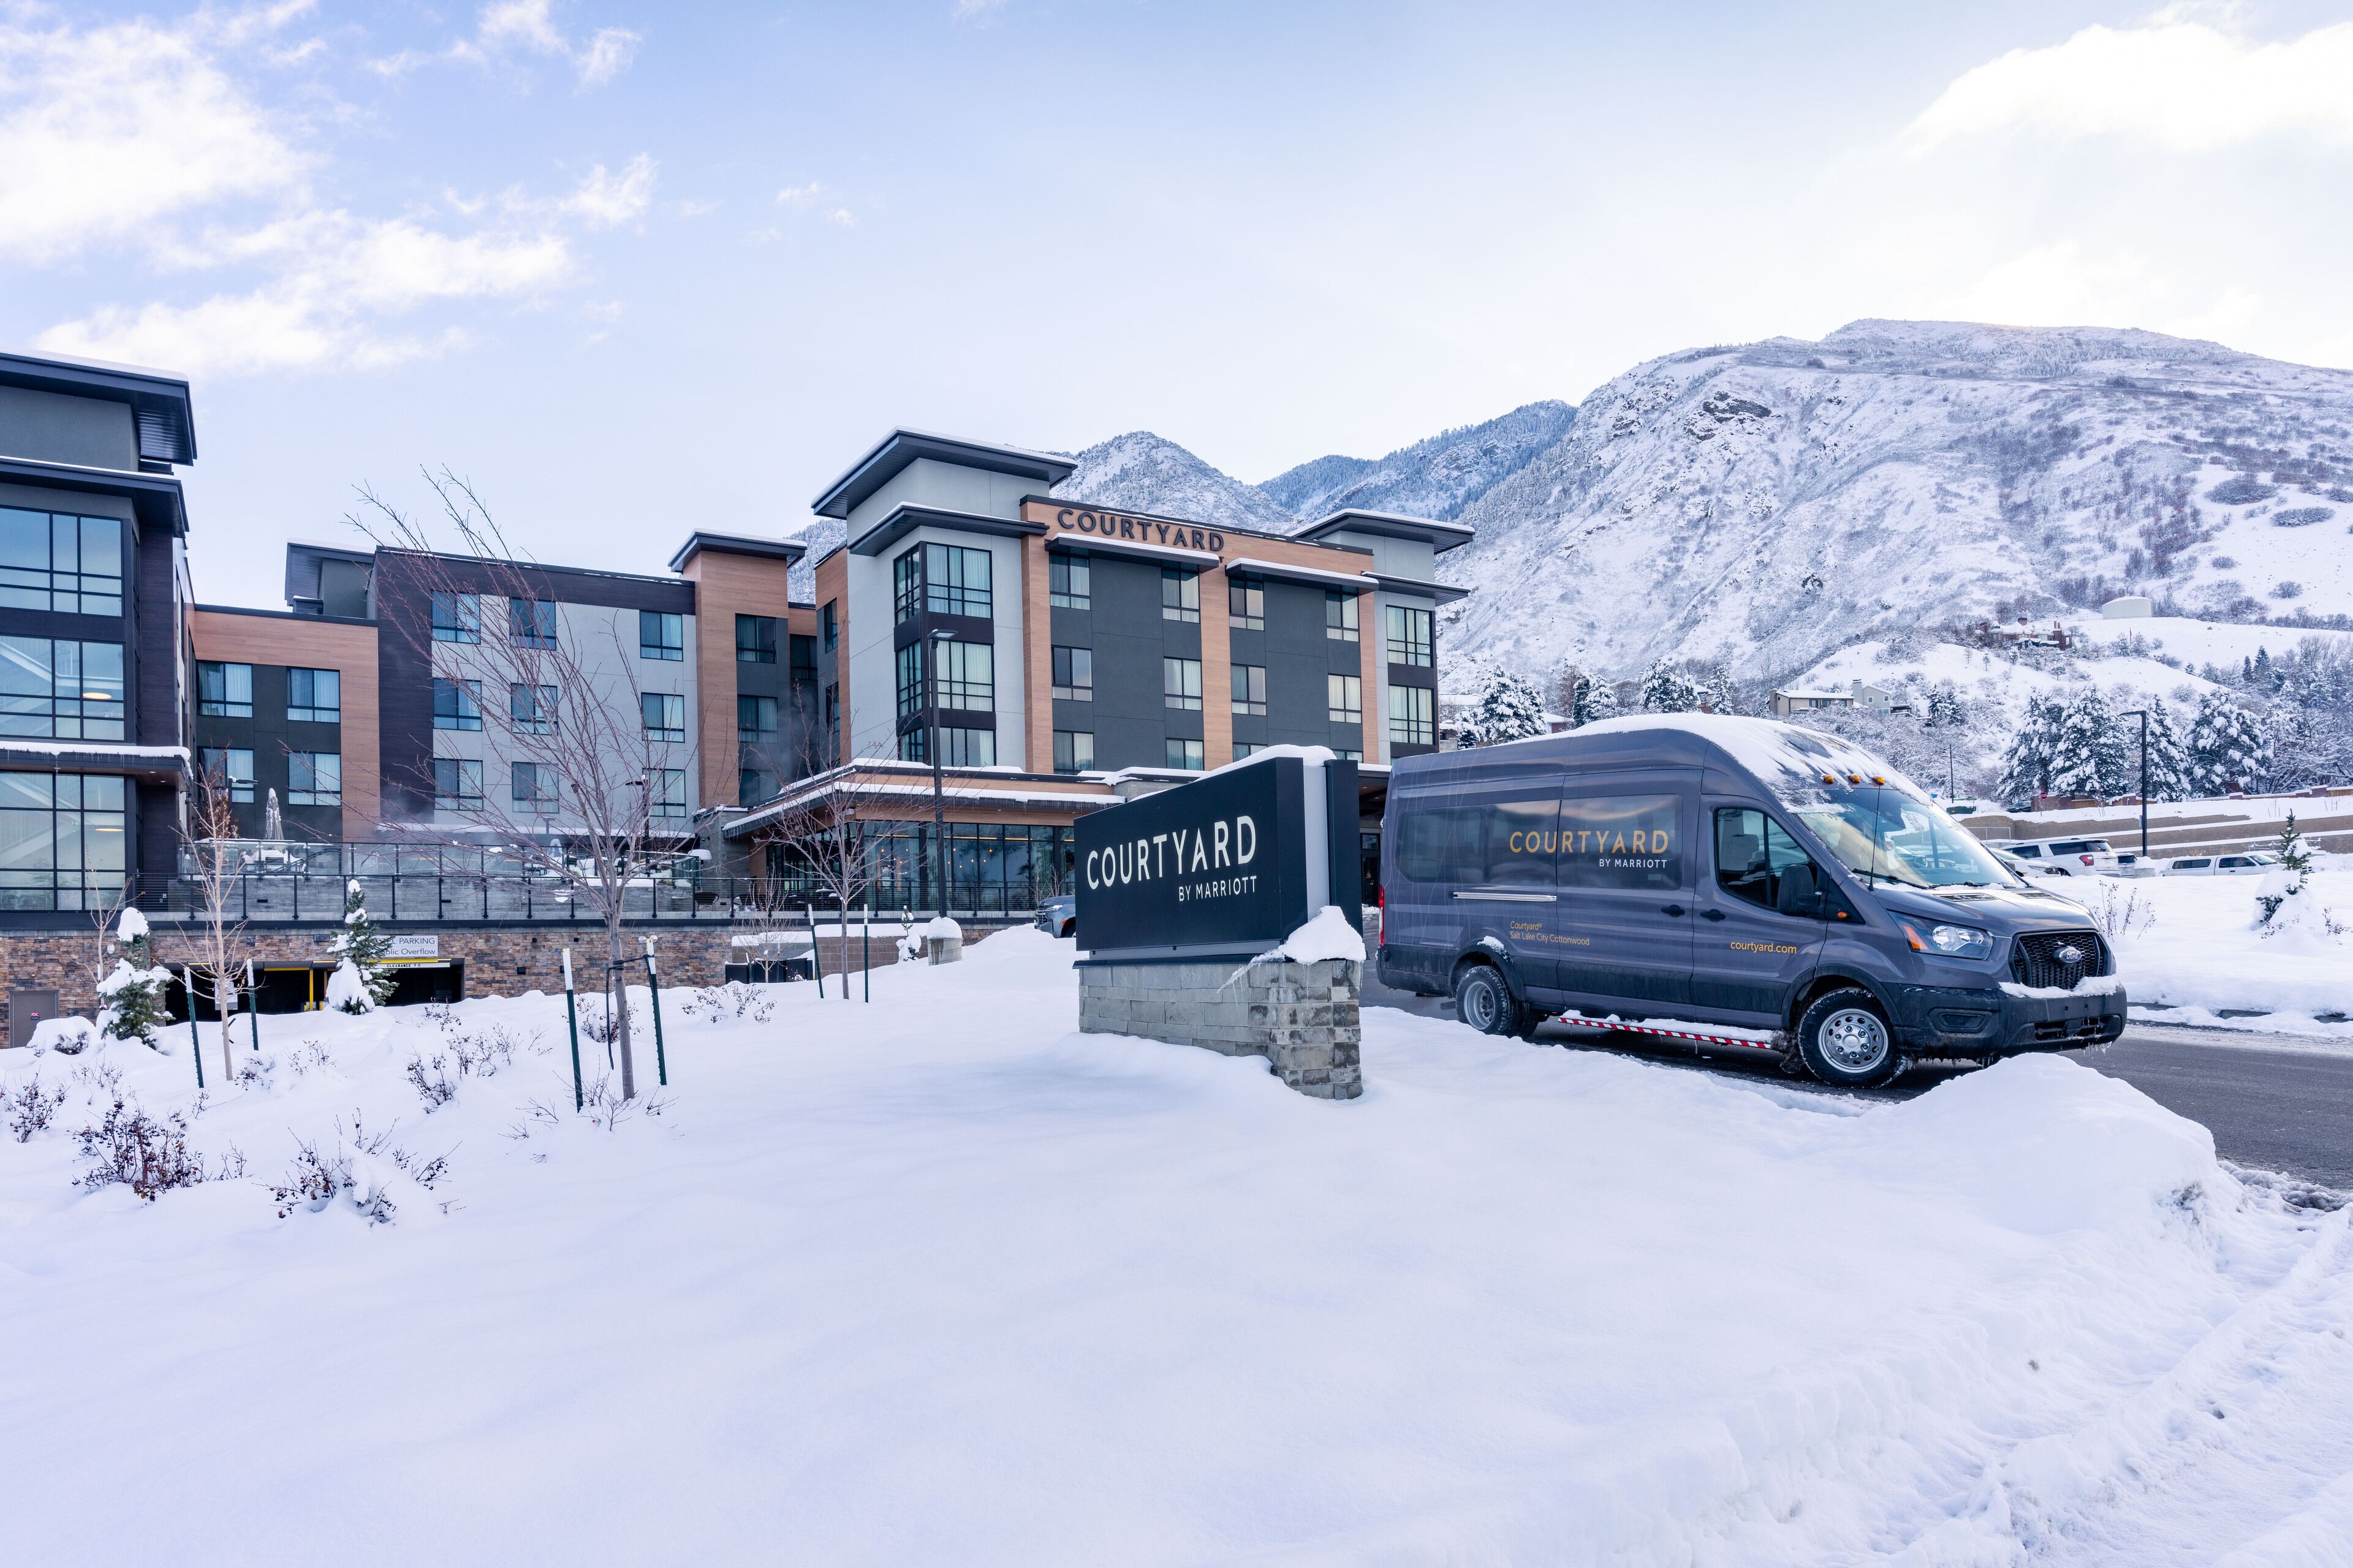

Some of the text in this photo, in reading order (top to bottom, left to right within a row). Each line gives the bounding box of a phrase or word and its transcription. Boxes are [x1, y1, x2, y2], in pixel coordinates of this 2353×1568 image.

[1058, 509, 1224, 551] COURTYARD
[1087, 815, 1256, 890] COURTYARD
[1599, 858, 1667, 868] BY MARRIOTT
[1179, 875, 1257, 902] BY MARRIOTT
[1522, 932, 1535, 941] Lake
[1536, 933, 1548, 944] City
[1550, 934, 1590, 945] Cottonwood
[1730, 942, 1797, 954] courtyard.com
[2067, 951, 2078, 960] Ford
